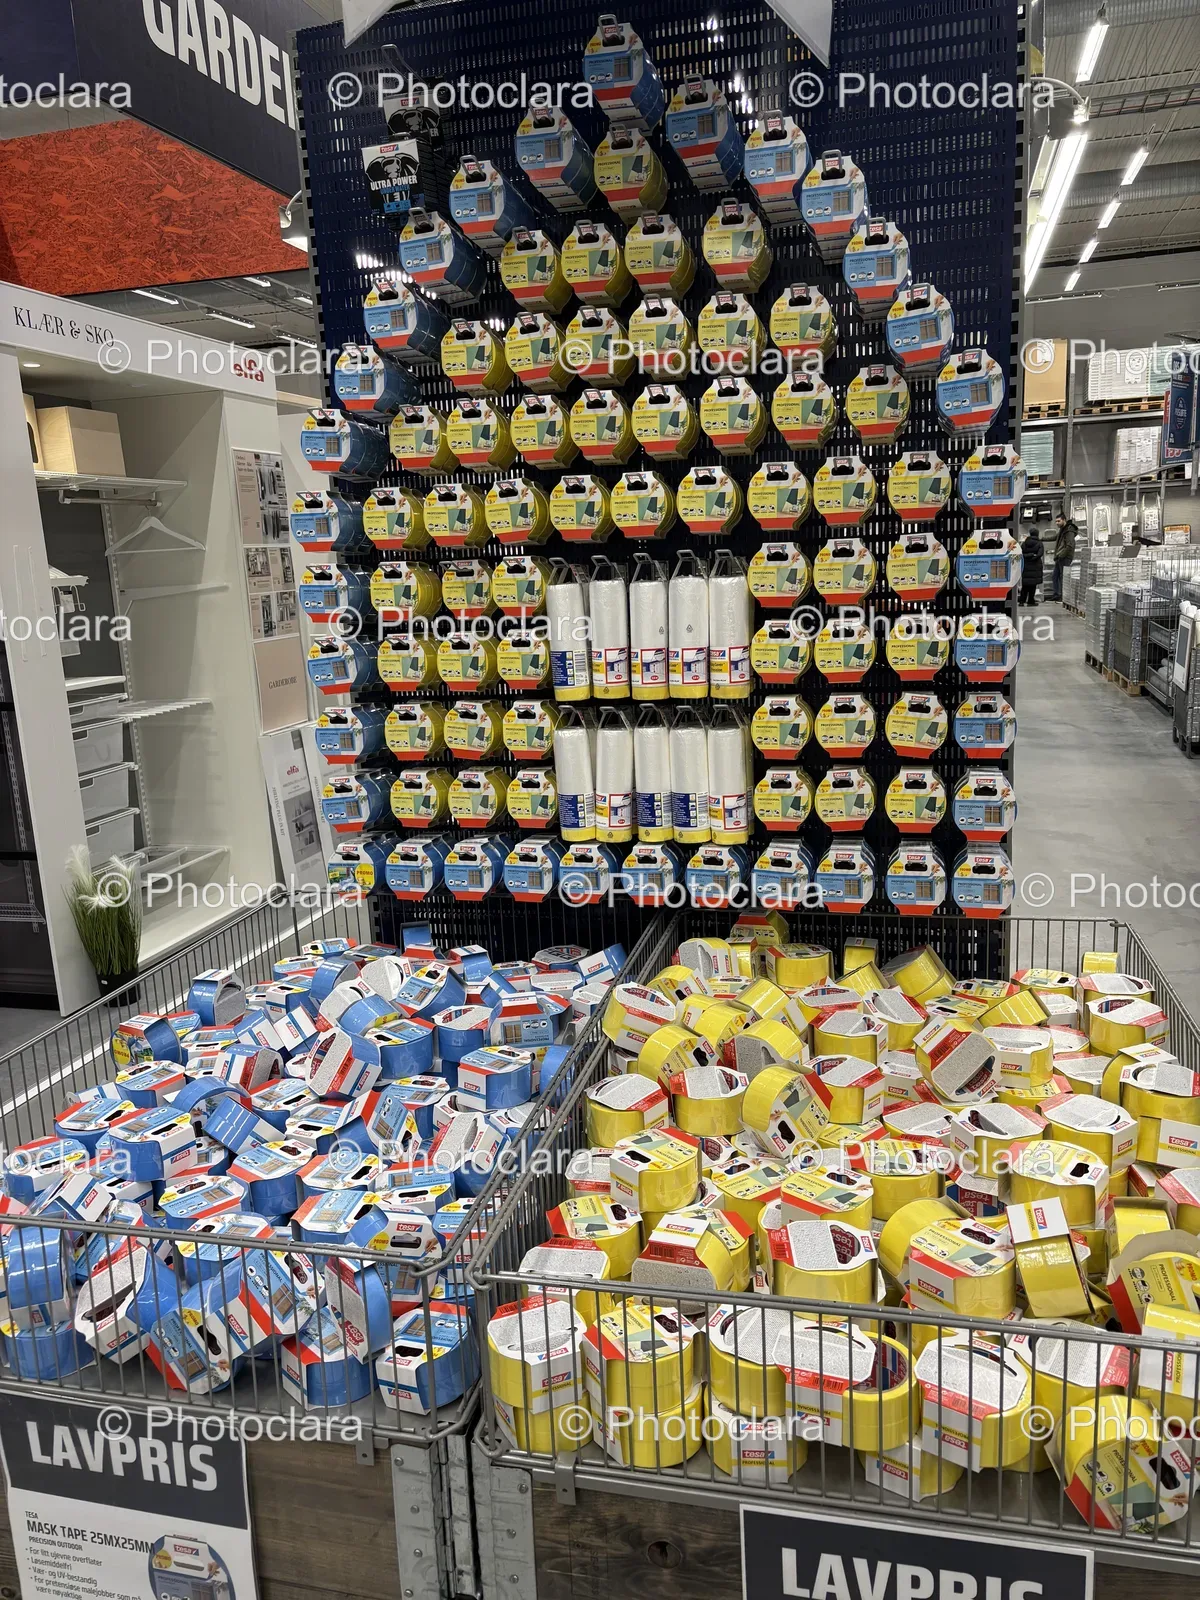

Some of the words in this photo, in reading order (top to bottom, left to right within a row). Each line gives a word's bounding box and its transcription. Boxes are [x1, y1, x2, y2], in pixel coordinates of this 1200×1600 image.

[370, 179, 391, 191] ULTRA
[392, 175, 418, 186] POWER
[13, 306, 66, 337] KLÆR
[70, 320, 81, 337] &
[85, 324, 115, 347] SKO
[268, 676, 298, 690] GARDEROBE
[286, 765, 300, 776] elfa
[888, 1087, 905, 1095] tesa
[1169, 1136, 1190, 1146] tesa
[1167, 1145, 1196, 1155] PROFESSIONAL
[964, 1191, 990, 1202] tesa
[1034, 1208, 1045, 1225] tesa
[397, 1223, 418, 1232] tesa
[928, 1228, 962, 1247] PROFESSIONAL
[1186, 1263, 1198, 1281] PROMO
[918, 1279, 938, 1293] tesa
[1159, 1263, 1176, 1302] PROFESSIONAL
[943, 1433, 967, 1450] tesa
[26, 1421, 218, 1491] LAVPRIS
[743, 1451, 765, 1459] tesa
[1171, 1450, 1189, 1472] tesa
[884, 1464, 908, 1480] tesa
[25, 1511, 38, 1519] TESA
[27, 1520, 58, 1536] MASK
[60, 1526, 88, 1541] TAPE
[28, 1536, 56, 1546] PRECISION
[57, 1542, 83, 1551] OUTDOOR
[30, 1547, 40, 1555] For
[72, 1555, 102, 1566] overflater
[34, 1576, 44, 1584] For
